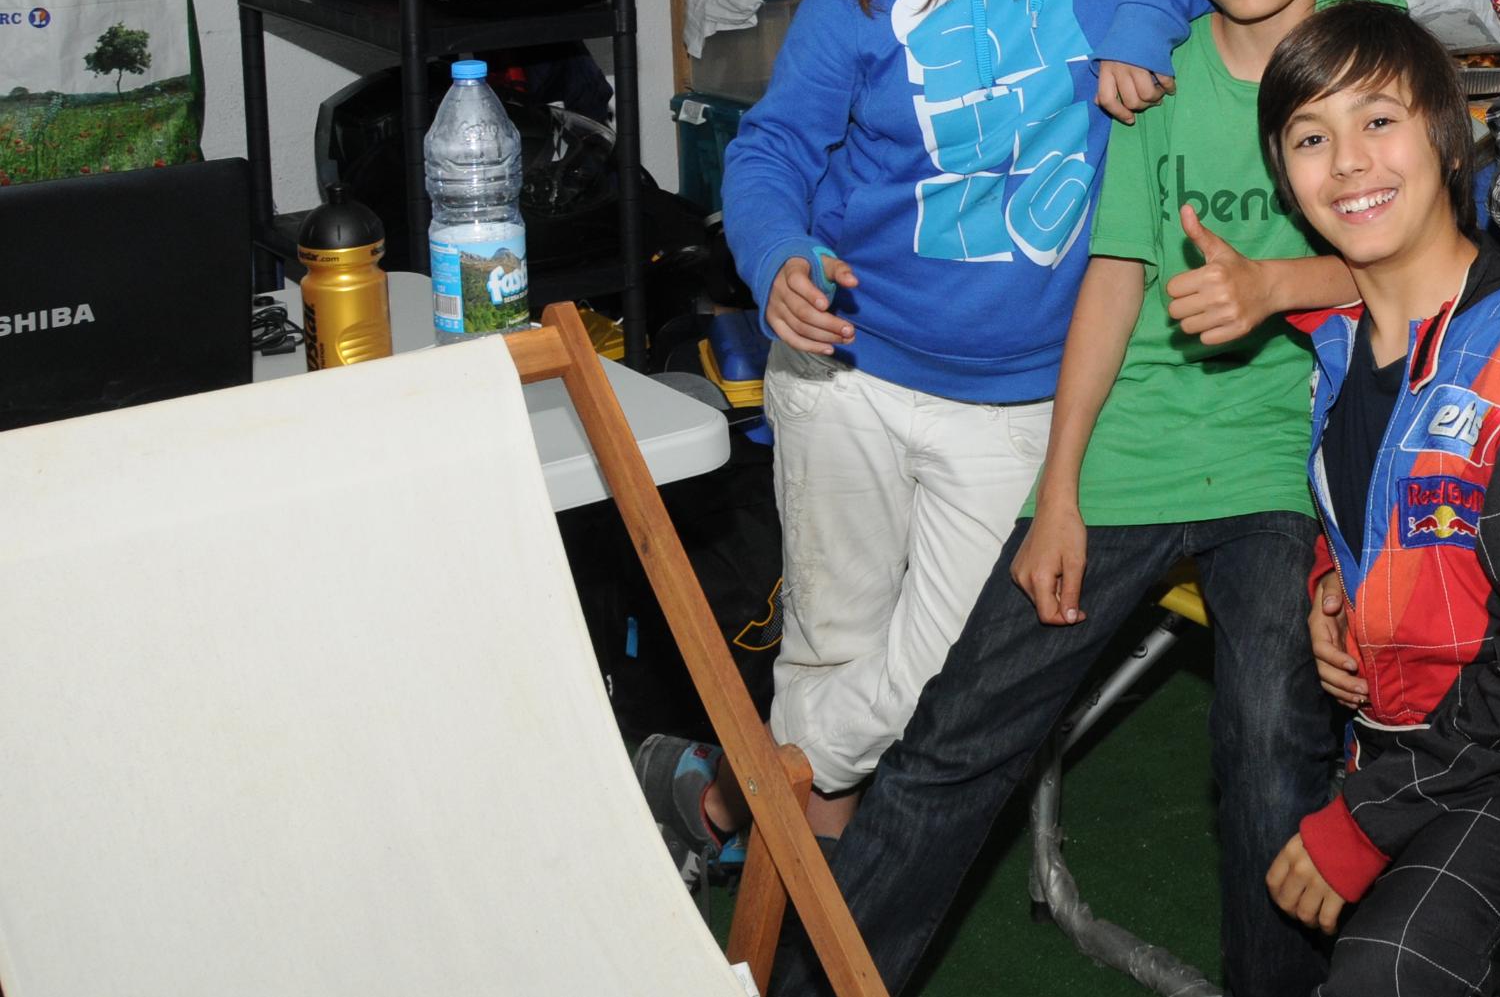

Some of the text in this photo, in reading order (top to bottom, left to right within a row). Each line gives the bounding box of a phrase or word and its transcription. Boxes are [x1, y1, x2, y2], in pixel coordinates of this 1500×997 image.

[0, 303, 96, 337] SHIBA
[1407, 480, 1485, 514] Red Bull
